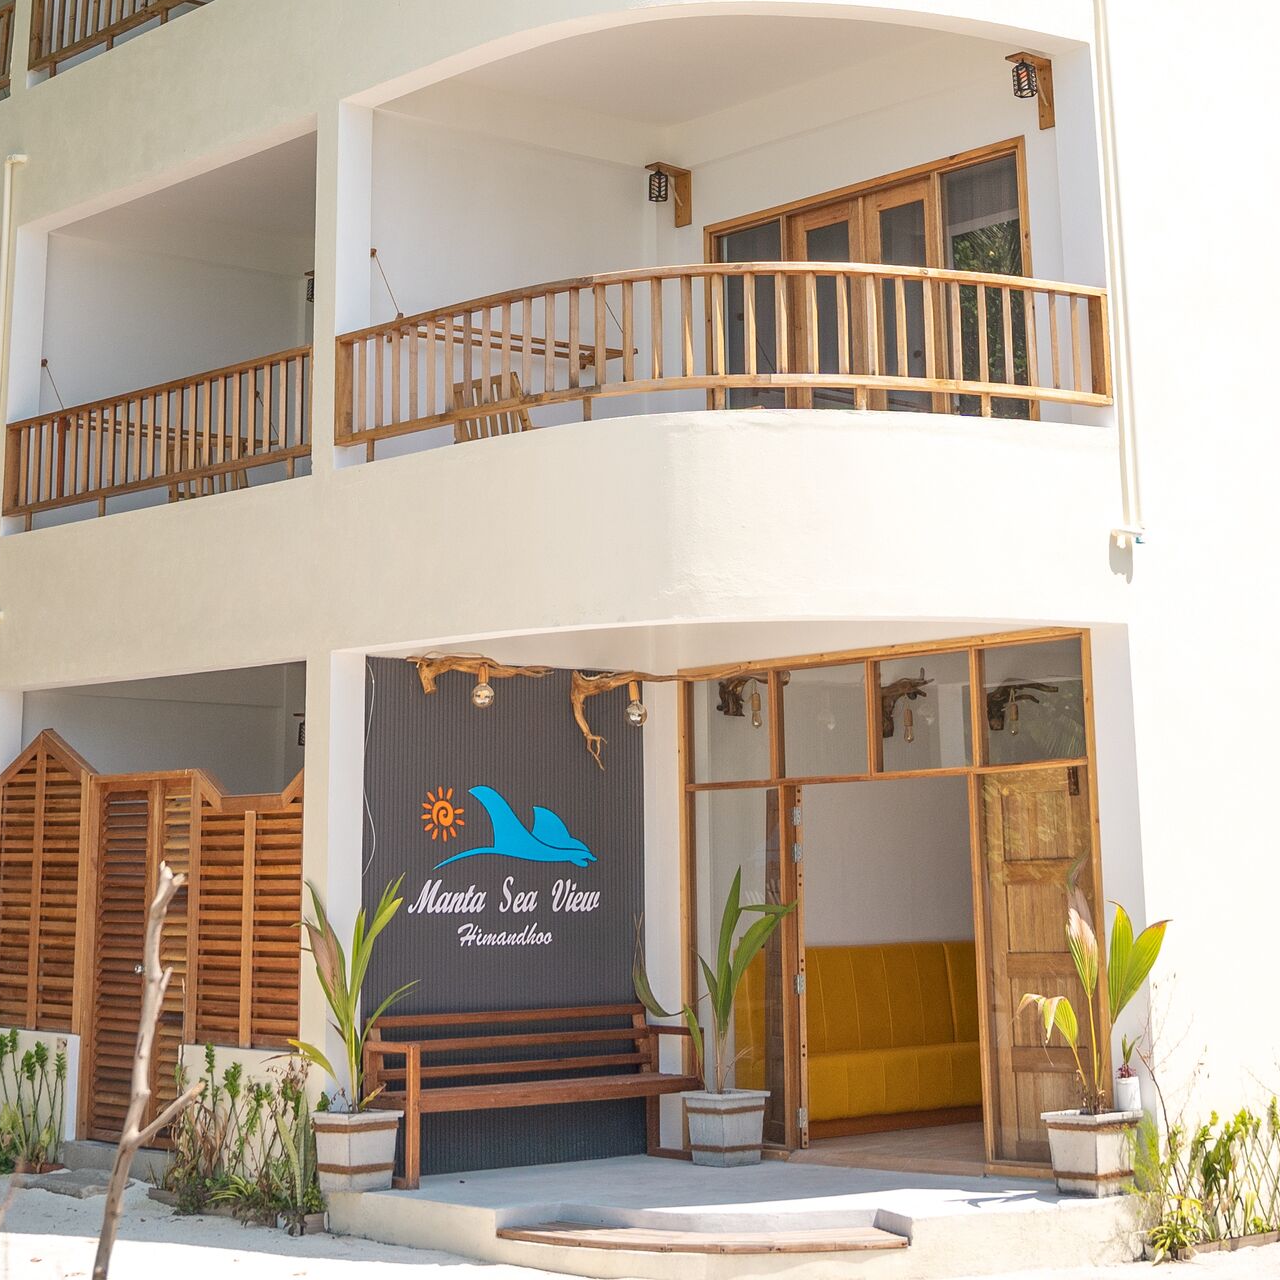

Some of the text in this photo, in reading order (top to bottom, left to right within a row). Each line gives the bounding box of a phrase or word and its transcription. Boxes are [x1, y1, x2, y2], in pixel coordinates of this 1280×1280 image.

[407, 876, 600, 914] Manta Sea View
[457, 923, 553, 947] Himandhoo
